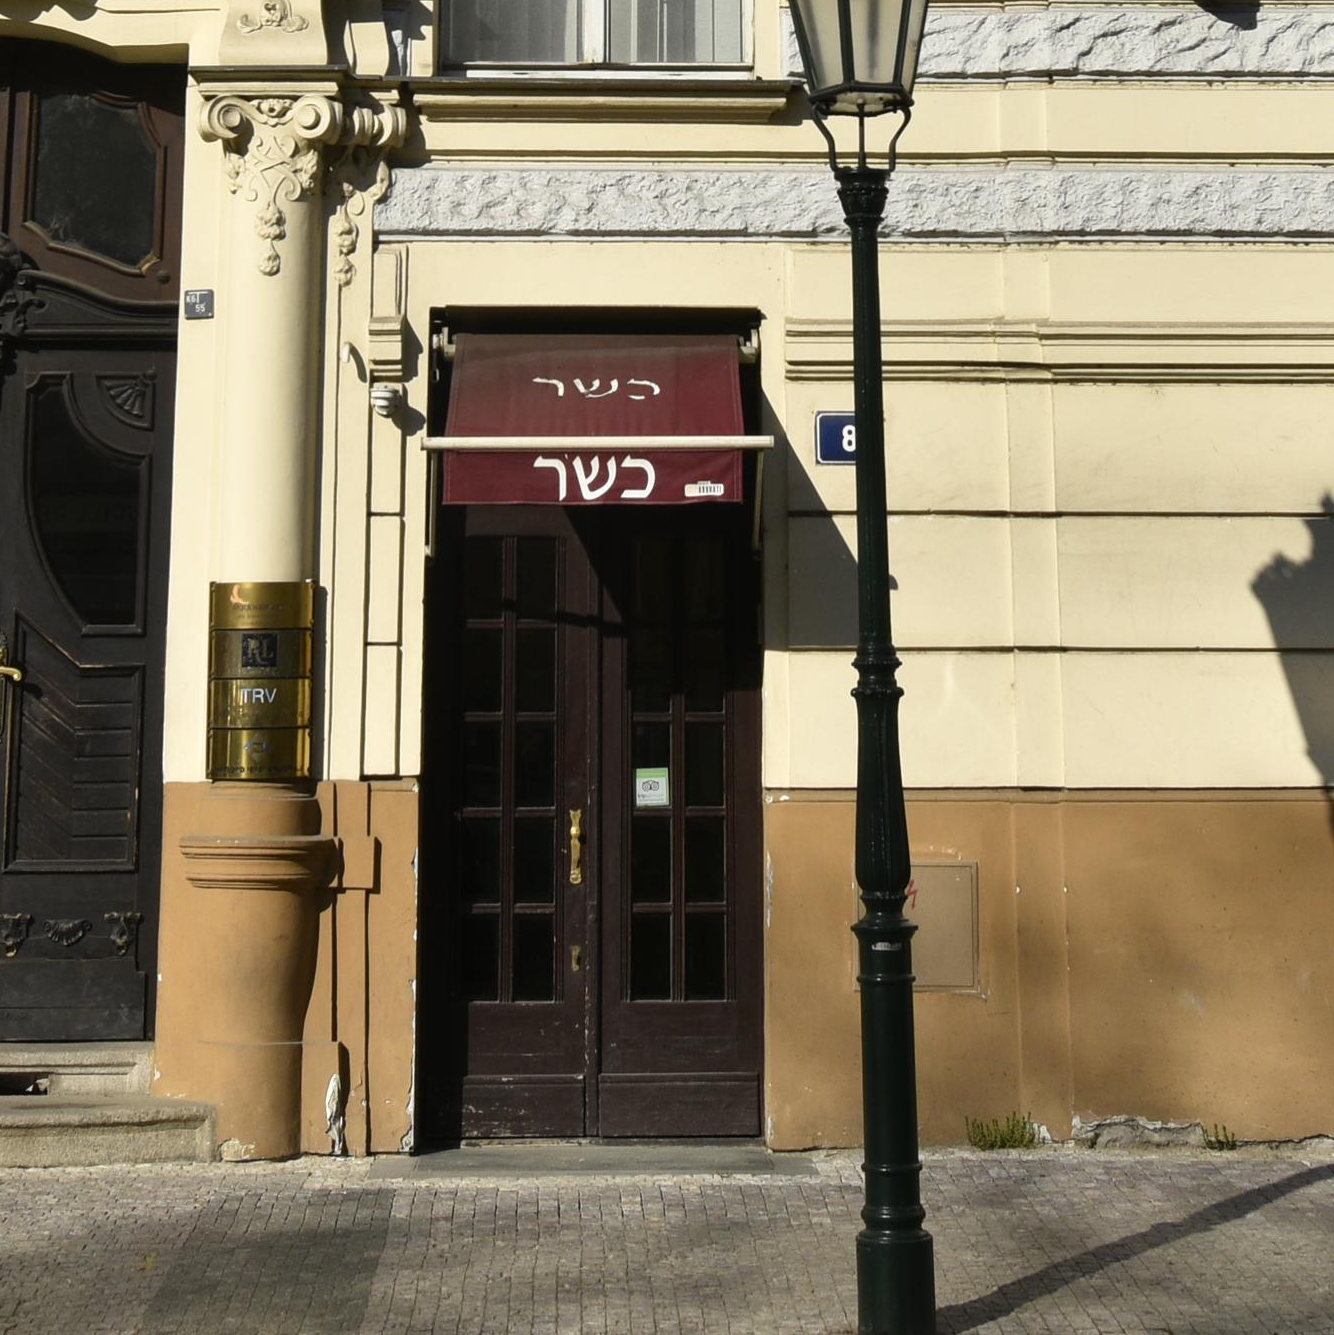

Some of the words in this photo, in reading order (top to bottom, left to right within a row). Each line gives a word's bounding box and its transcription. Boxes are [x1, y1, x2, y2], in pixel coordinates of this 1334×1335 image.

[842, 424, 856, 452] 8
[533, 454, 656, 502] כשר
[241, 687, 277, 704] TRV
